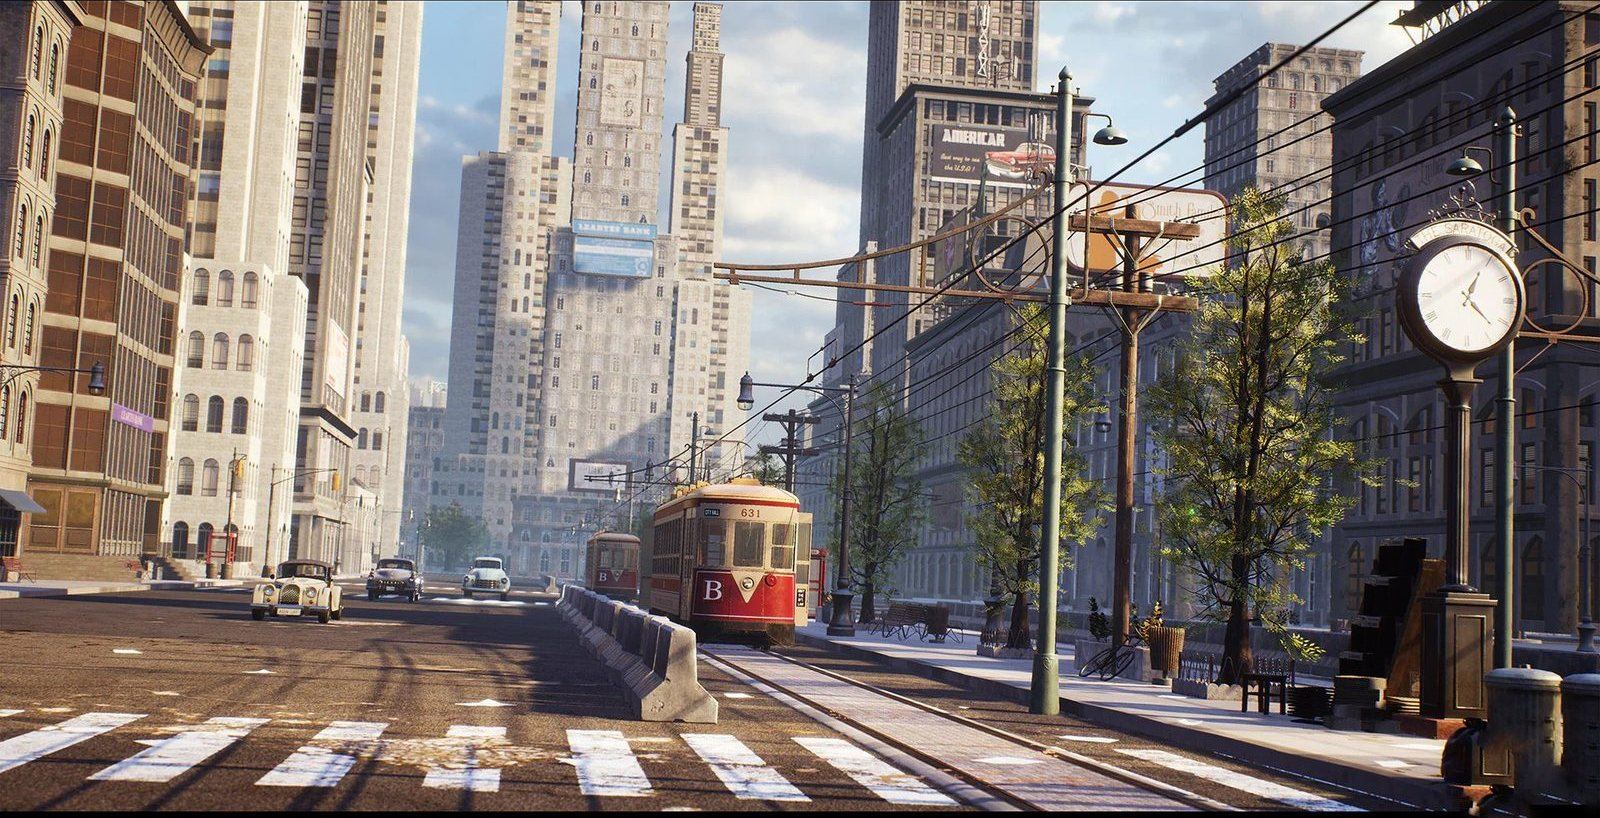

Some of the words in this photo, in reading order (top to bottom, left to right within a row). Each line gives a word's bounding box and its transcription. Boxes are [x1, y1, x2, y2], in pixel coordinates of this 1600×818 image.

[942, 128, 1005, 147] AMERICAR
[740, 508, 761, 518] 631
[600, 572, 607, 581] B
[703, 580, 722, 600] B
